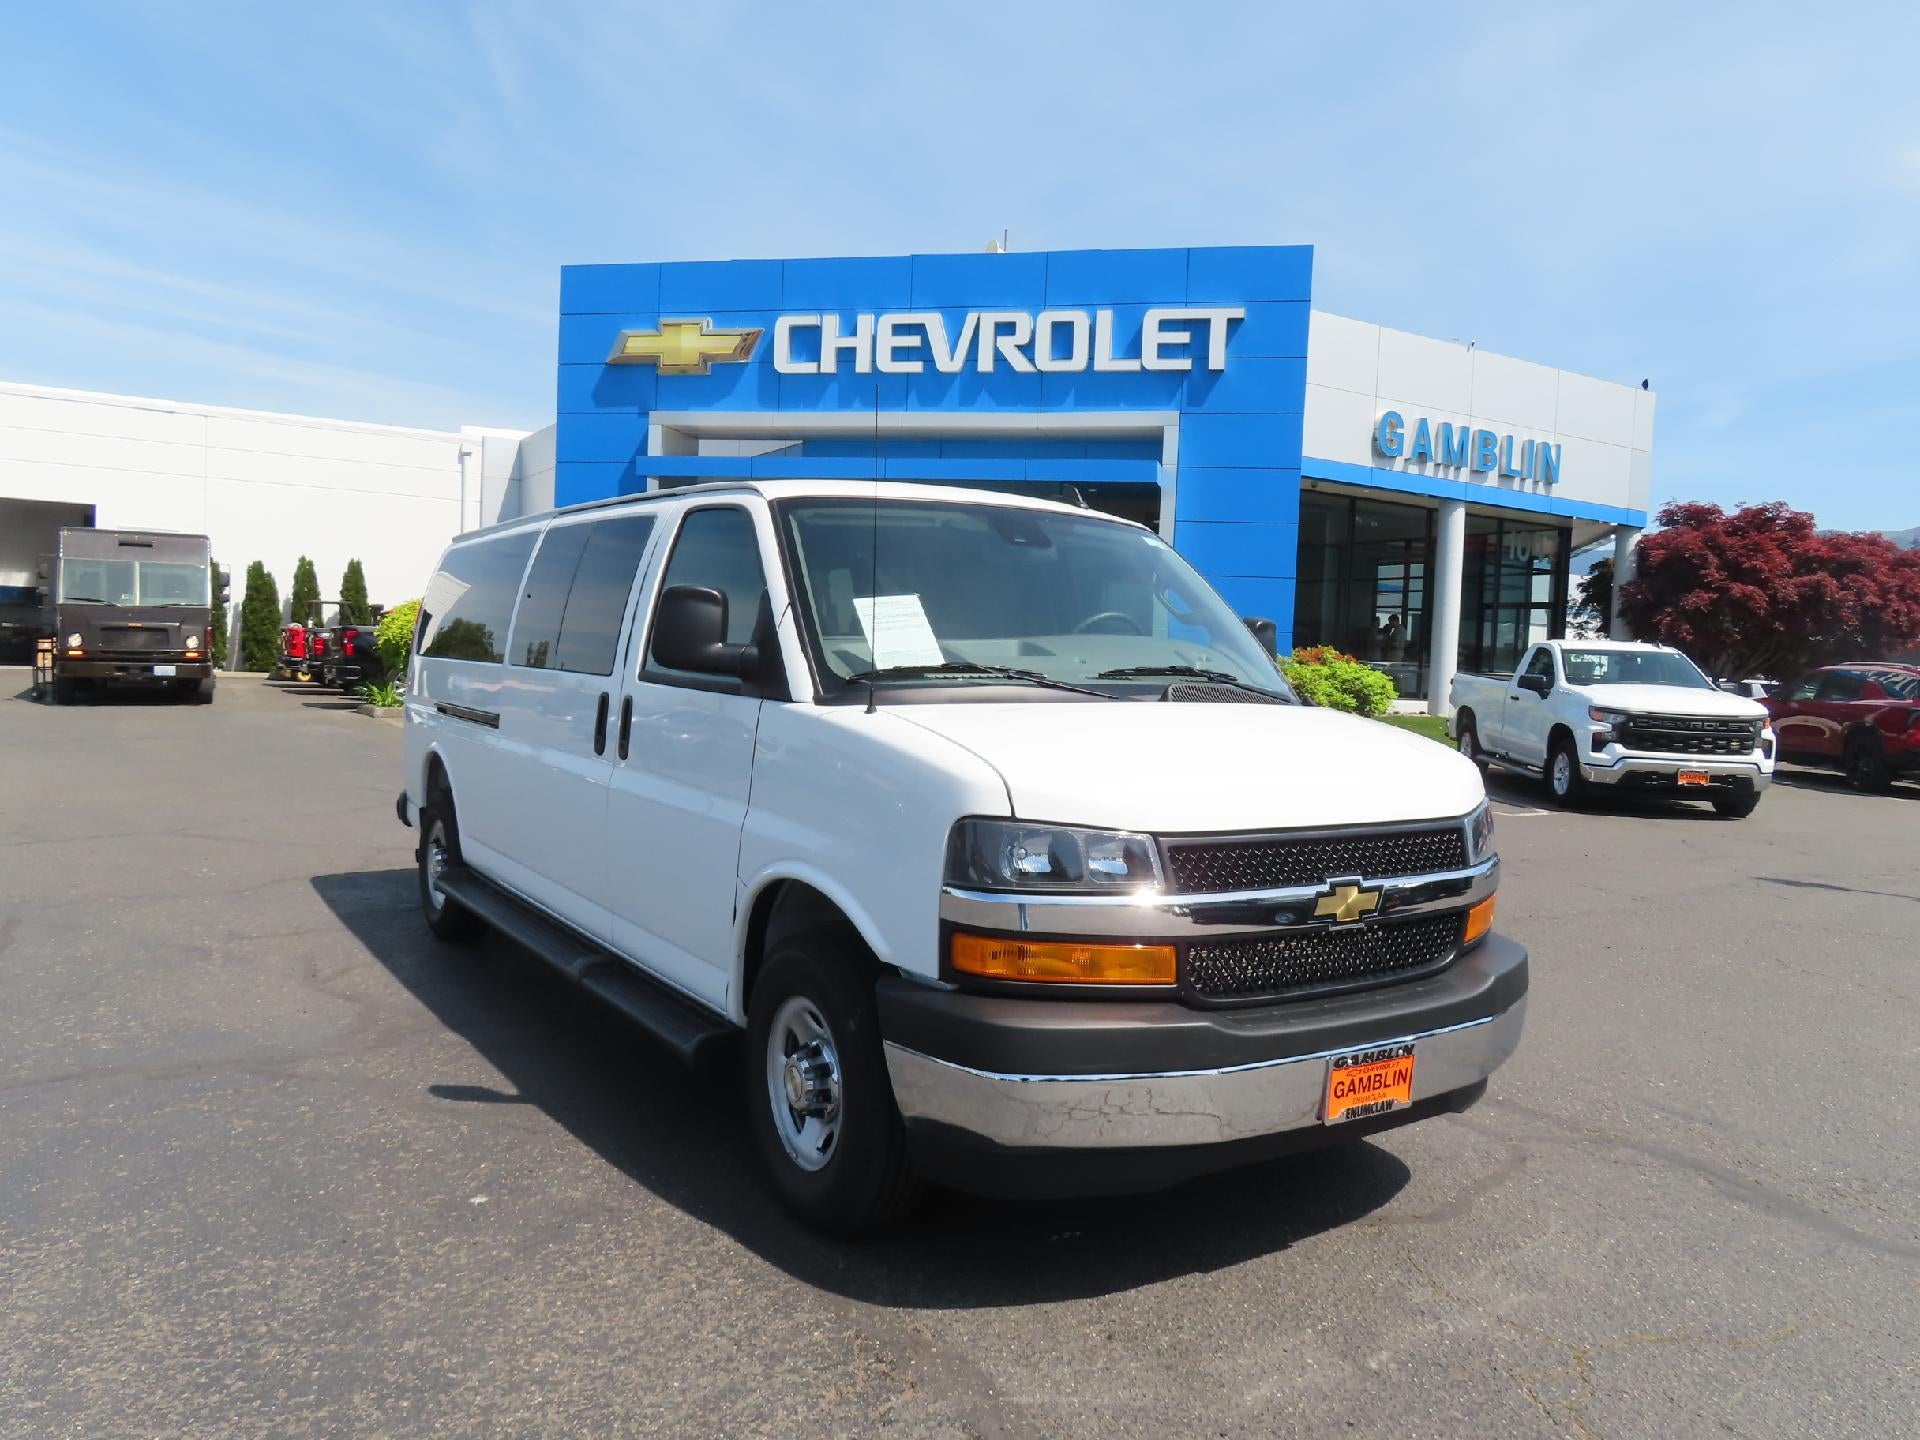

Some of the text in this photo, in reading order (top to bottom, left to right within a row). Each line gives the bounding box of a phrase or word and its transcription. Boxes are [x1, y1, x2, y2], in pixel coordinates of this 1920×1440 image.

[773, 308, 1246, 374] CHEVROLET
[1373, 410, 1562, 484] GAMBLIN
[1333, 1044, 1415, 1069] GAMBLIN
[1363, 1062, 1400, 1074] CHEVROLET
[1334, 1067, 1408, 1099] GAMBLIN
[1345, 1099, 1393, 1119] ENUMCLAW
